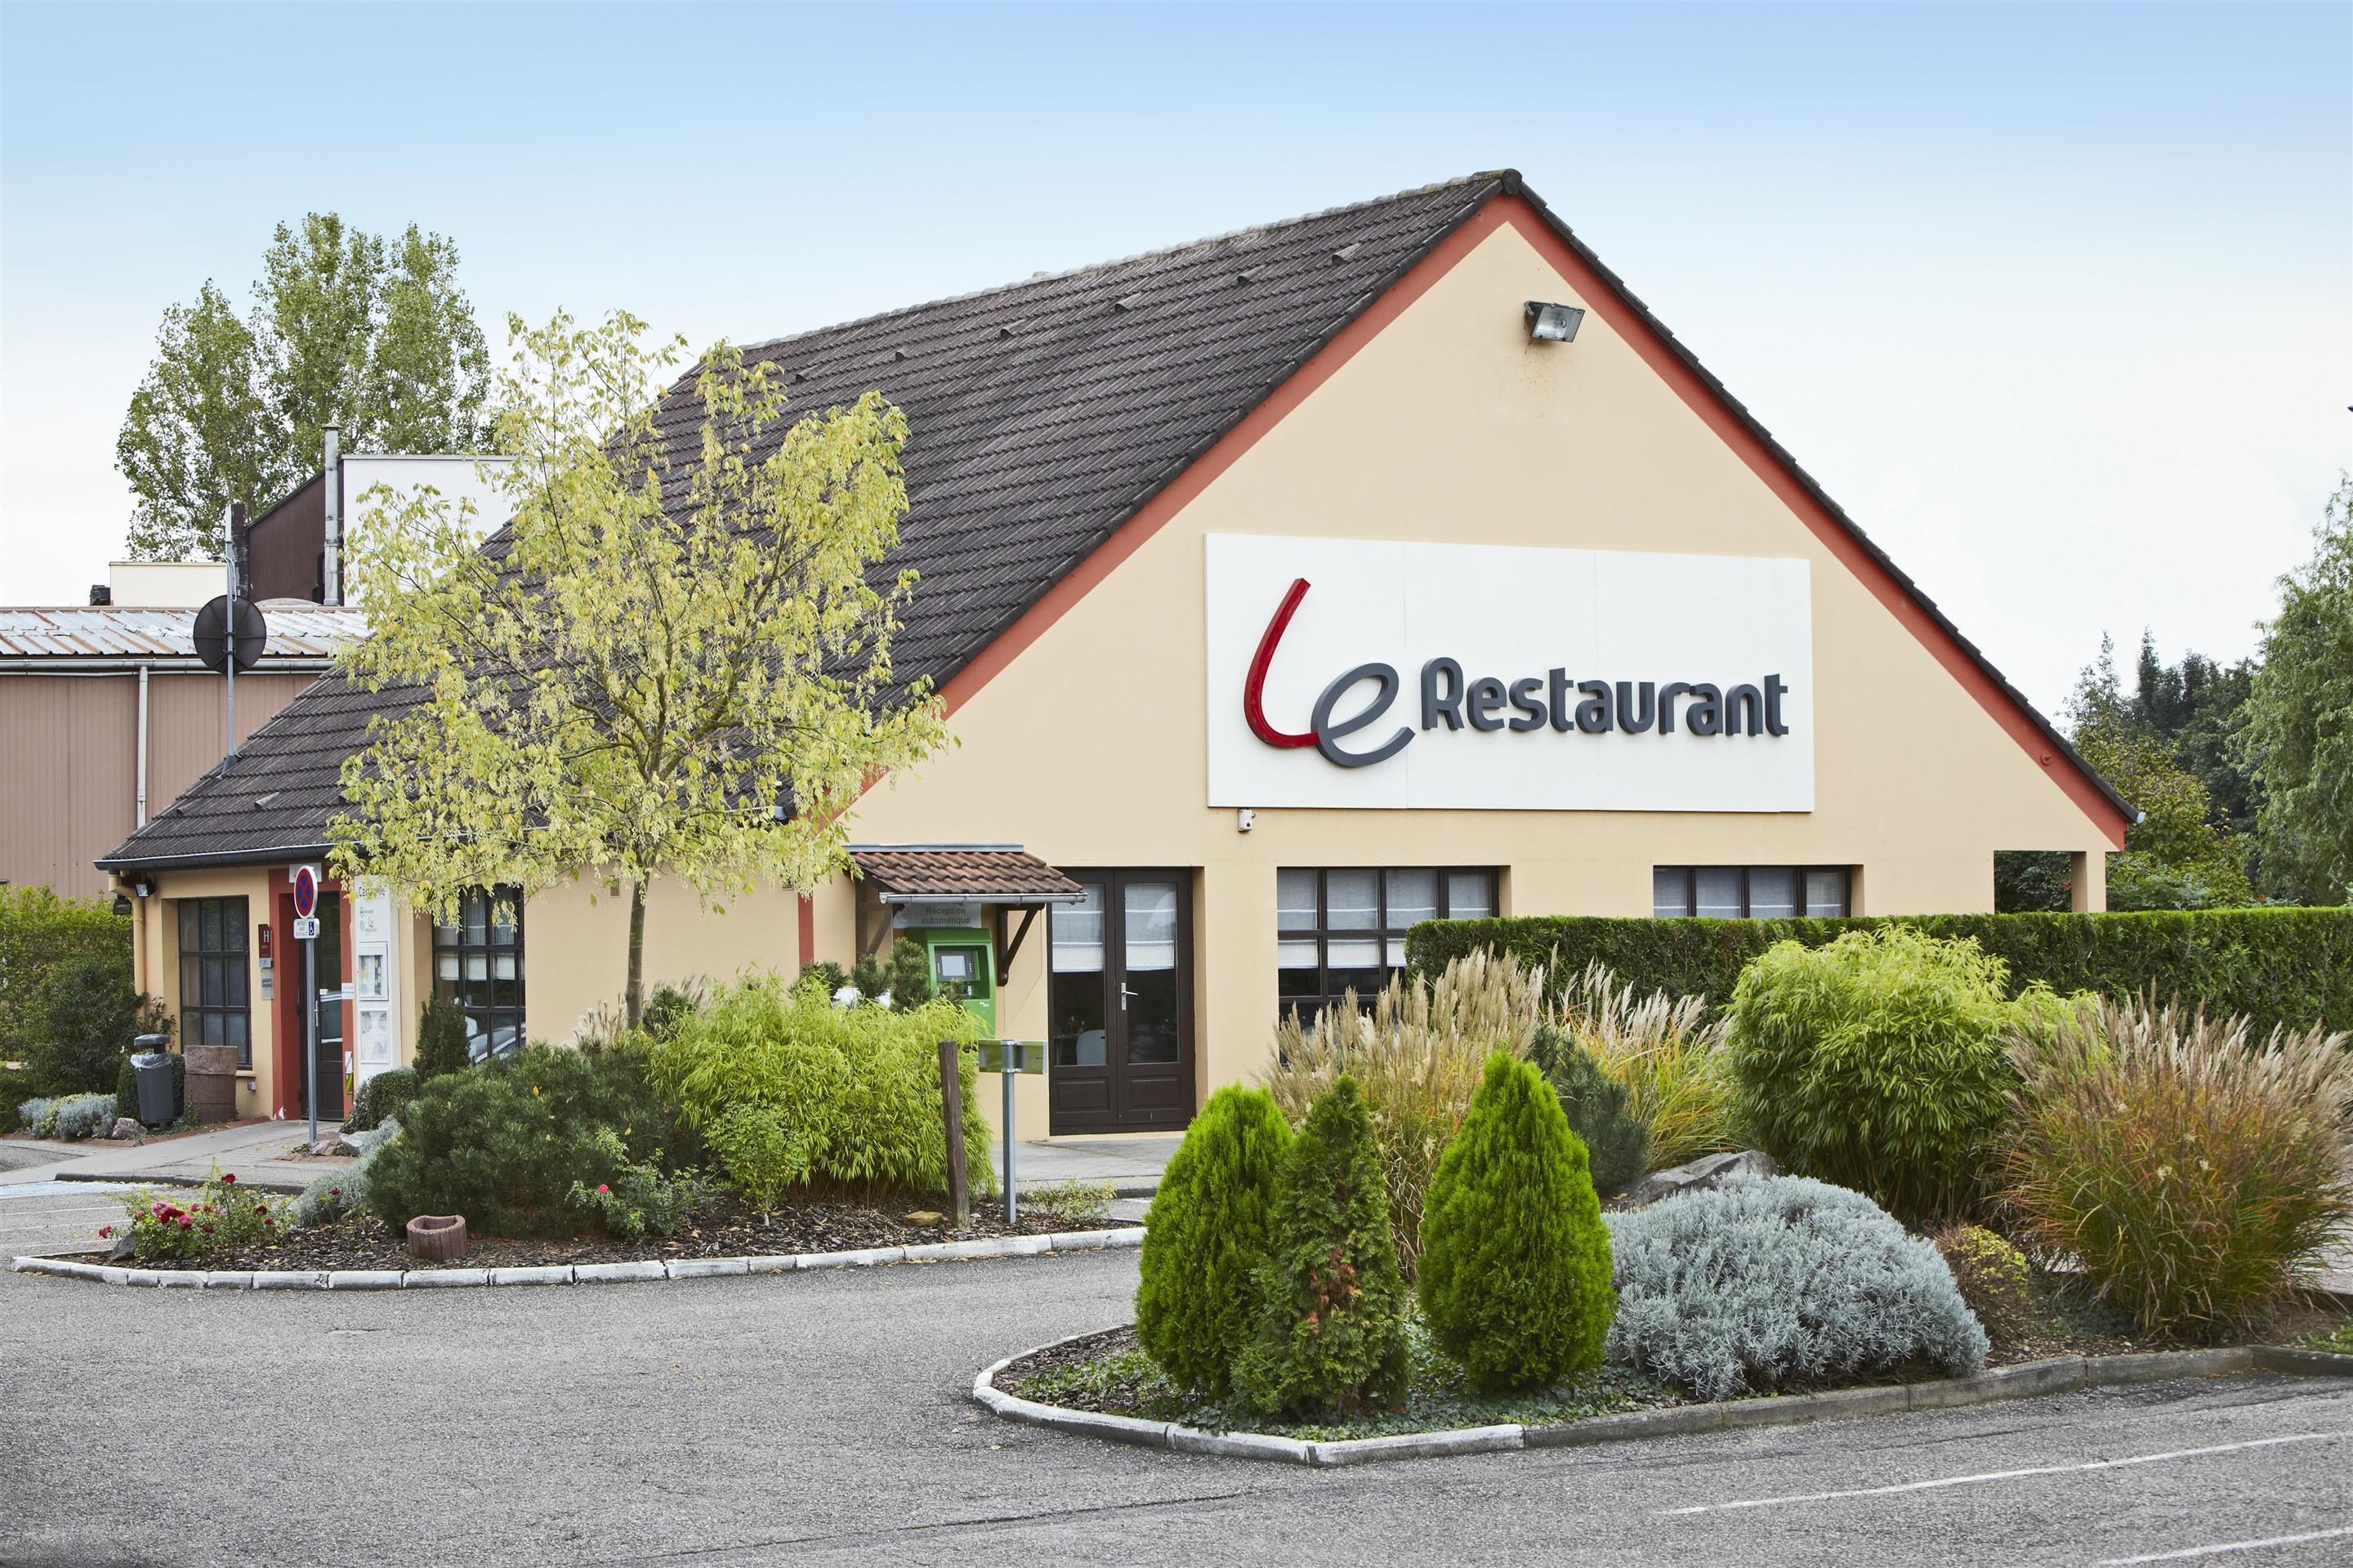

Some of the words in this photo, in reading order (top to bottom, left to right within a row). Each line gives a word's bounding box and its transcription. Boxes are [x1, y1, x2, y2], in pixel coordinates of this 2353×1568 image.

[1243, 578, 1416, 767] Le
[1421, 657, 1789, 736] Restaurant
[926, 906, 966, 916] Réception
[921, 917, 971, 925] automatique
[263, 930, 270, 943] H
